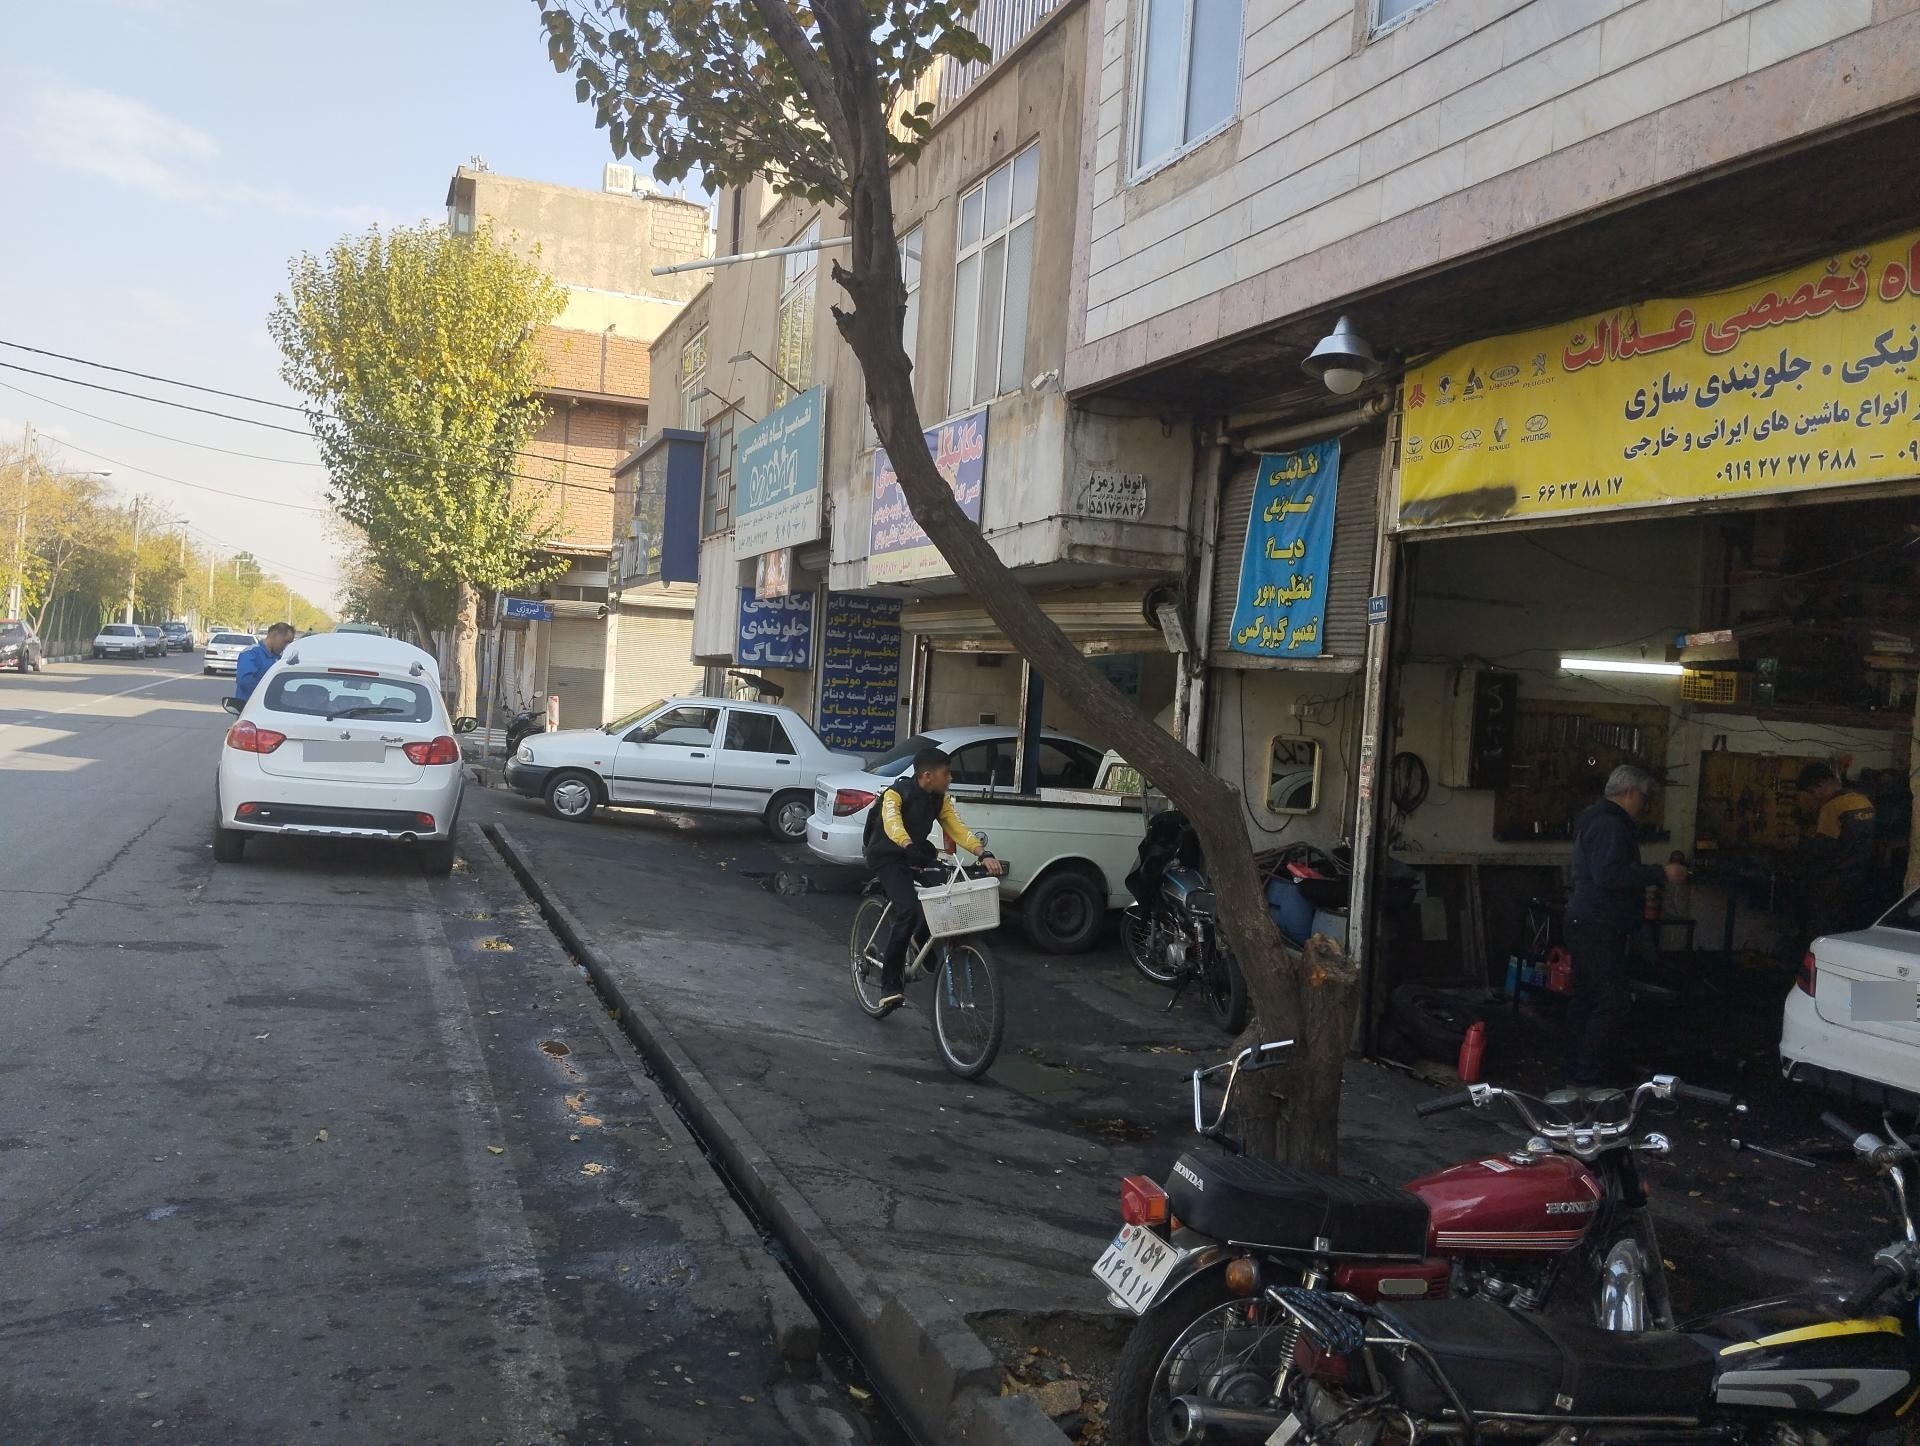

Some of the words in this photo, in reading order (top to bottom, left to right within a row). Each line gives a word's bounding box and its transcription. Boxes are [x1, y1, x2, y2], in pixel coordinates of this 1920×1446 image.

[1704, 252, 1871, 354] تخصصی
[1563, 308, 1695, 370] عدالت
[1842, 323, 1919, 384] نیکی
[1522, 377, 1555, 389] PEUGEOT
[1695, 348, 1811, 409] جلوبندی
[1625, 371, 1688, 420] سازی
[1855, 390, 1908, 427] انواع
[1753, 409, 1789, 441] های
[1795, 400, 1850, 436] ماشین
[1520, 432, 1552, 443] HYUNDAI
[1697, 414, 1749, 448] ایرانی
[1433, 438, 1451, 450] KIA
[1458, 442, 1483, 451] CHERY
[1488, 443, 1511, 452] RENAULT
[1624, 426, 1679, 459] خارجی
[1683, 432, 1692, 451] و
[1402, 456, 1424, 465] TOYOTA
[1089, 475, 1114, 493] زمزم
[1277, 574, 1314, 608] تنظیم
[516, 604, 540, 615] فیروزی
[741, 616, 809, 642] جلوبندی
[1237, 615, 1288, 649] گیربوکس
[1288, 617, 1318, 650] تعمیر
[876, 631, 900, 644] تعویض
[742, 642, 806, 667] دیاگ
[825, 644, 862, 658] موتور
[864, 645, 898, 658] تنظیم
[855, 660, 898, 675] تعویض
[823, 674, 861, 688] موتور
[863, 677, 897, 689] تعمیر
[822, 688, 845, 702] دینام
[846, 690, 867, 700] تسمه
[868, 691, 897, 705] تعویض
[822, 703, 859, 718] دیاگ
[861, 704, 896, 717] دستگاه
[870, 721, 895, 734] تعمیر
[836, 735, 858, 747] دوره
[860, 736, 893, 749] سرویس
[1173, 1161, 1204, 1191] HONDA
